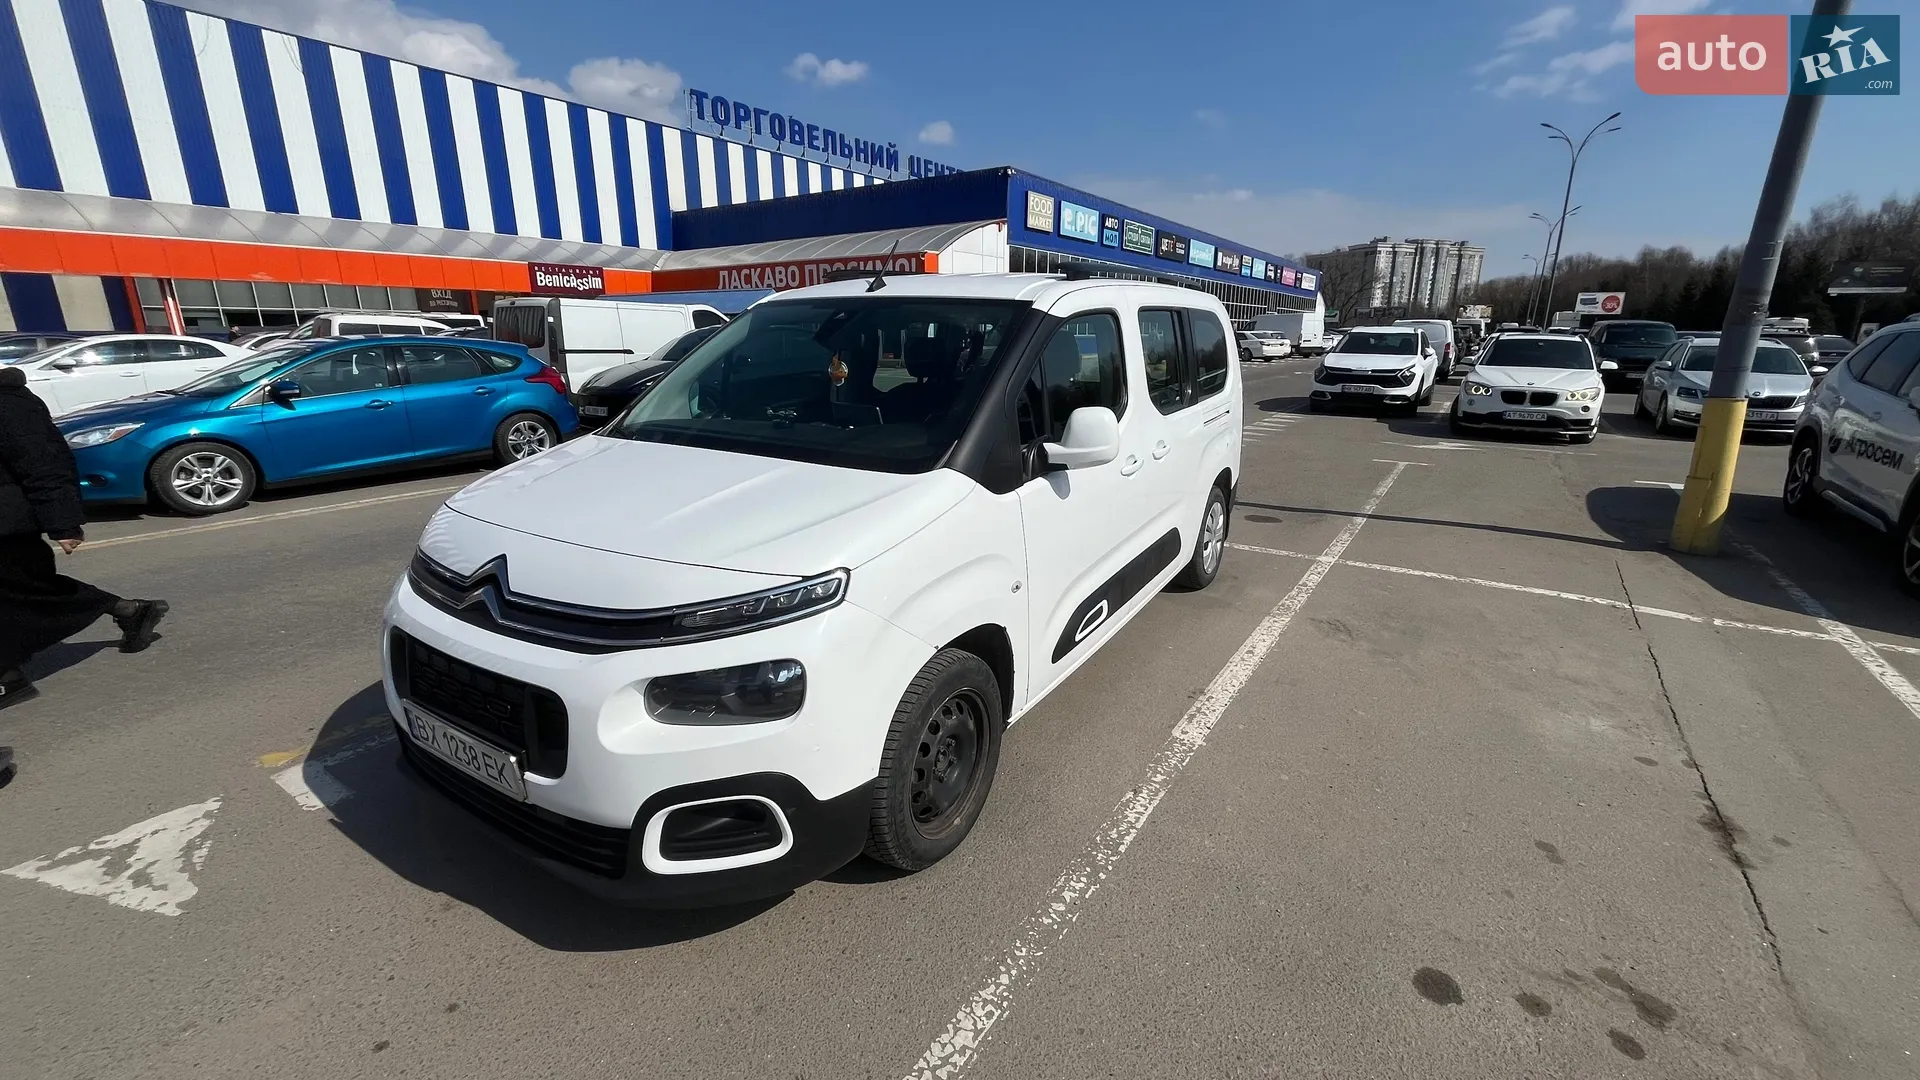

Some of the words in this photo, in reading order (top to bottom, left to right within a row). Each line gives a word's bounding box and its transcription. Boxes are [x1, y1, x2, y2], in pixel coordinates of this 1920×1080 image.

[690, 88, 899, 172] ТОРГОВЕЛЬНИЙ
[908, 154, 964, 179] ЦЕНТ
[1029, 196, 1052, 214] FOOD
[1029, 214, 1052, 229] MARKET
[534, 266, 600, 275] RESTAURANT
[718, 265, 800, 290] ЛАСКАВО
[430, 289, 452, 299] ВХІД
[415, 714, 441, 750] BX
[443, 731, 481, 772] 1238
[481, 750, 513, 790] EK
